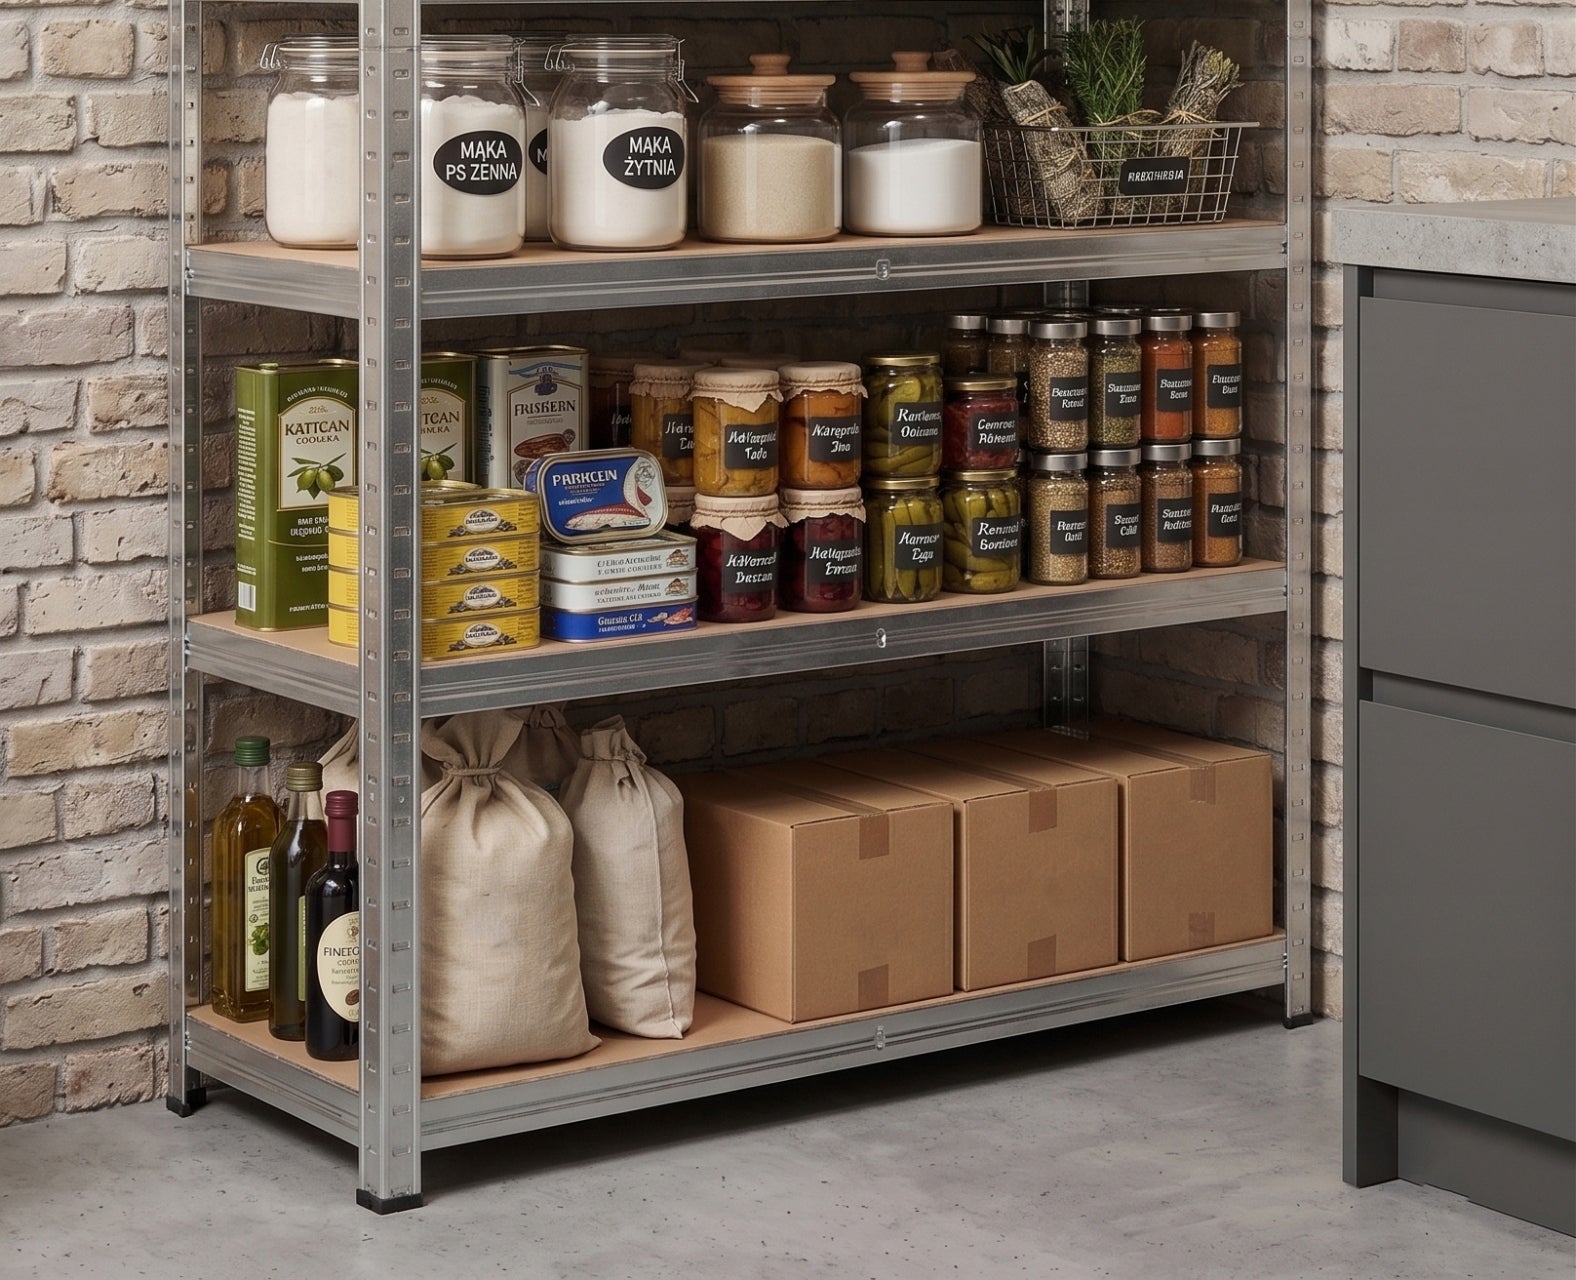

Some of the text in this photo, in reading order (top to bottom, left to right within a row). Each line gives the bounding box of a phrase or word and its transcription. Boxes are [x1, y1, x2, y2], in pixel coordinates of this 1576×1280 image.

[461, 140, 507, 162] MĄKA
[629, 136, 672, 156] MĄKA
[624, 156, 676, 176] ŻYTNIA
